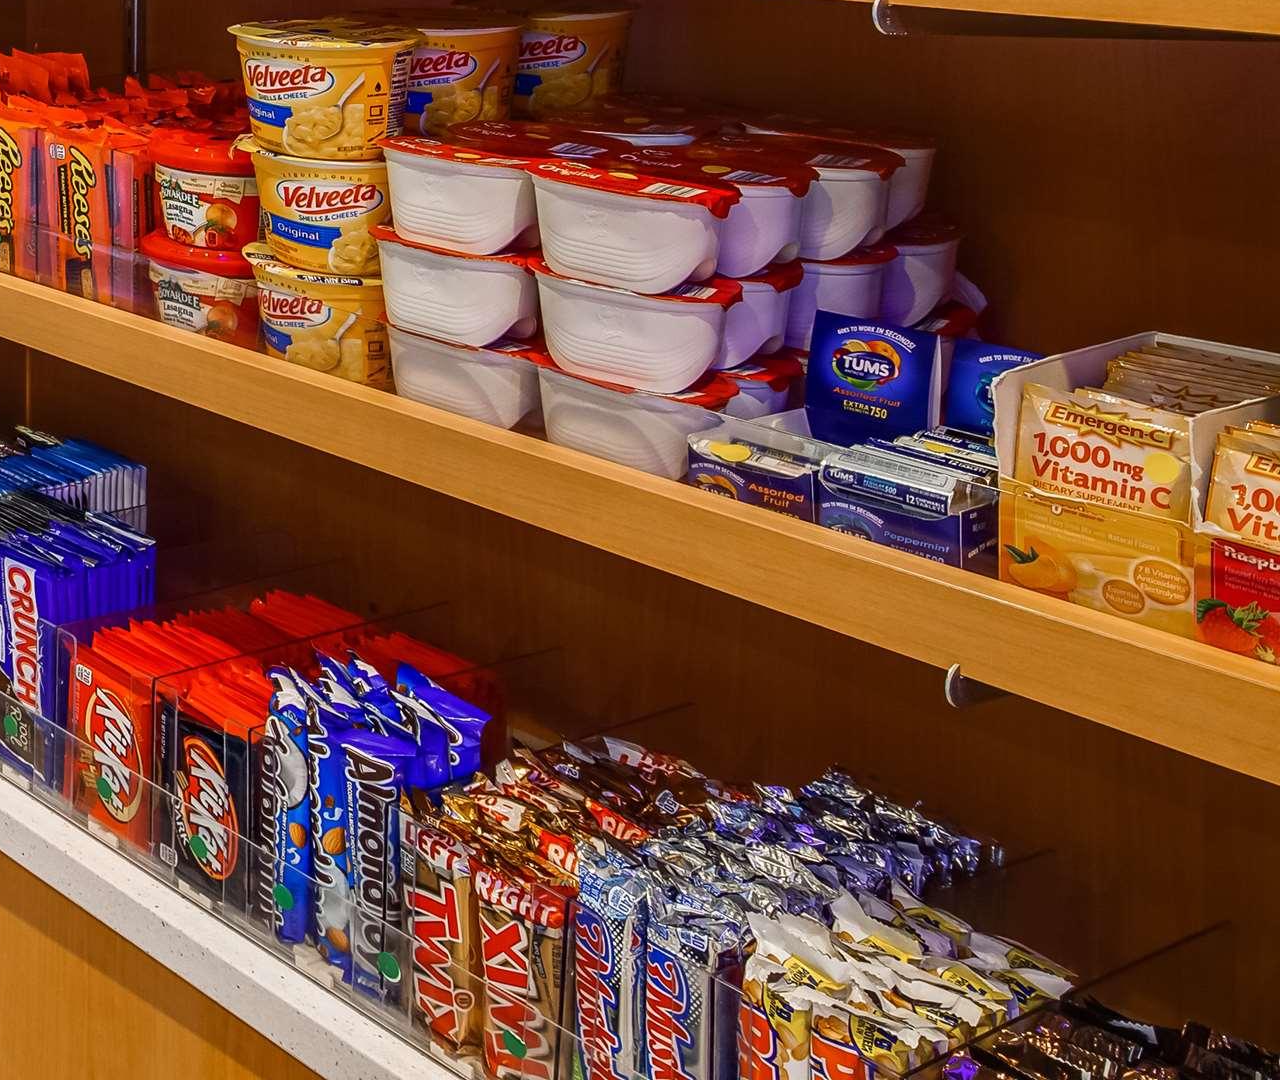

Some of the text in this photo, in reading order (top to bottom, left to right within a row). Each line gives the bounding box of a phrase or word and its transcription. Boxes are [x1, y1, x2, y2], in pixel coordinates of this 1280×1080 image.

[247, 63, 327, 88] Velveeta
[424, 77, 451, 86] CHEESE
[258, 91, 309, 101] SHELLS CHEESE
[538, 163, 601, 180] Original
[68, 145, 96, 259] Reese's
[165, 201, 194, 216] Lasagna
[282, 183, 377, 209] Velveeta
[298, 210, 359, 222] SHELLS CHEESE
[277, 222, 320, 242] Original
[858, 325, 917, 350] WORK IN SECONDS!
[842, 355, 890, 377] TUMS
[1002, 354, 1023, 362] WORK
[843, 399, 888, 419] EXTRA 750
[1050, 406, 1165, 444] Emergen-C
[1033, 432, 1145, 482] 1,000 mg
[829, 470, 854, 482] TUMS
[1031, 455, 1173, 510] Vitamin C
[747, 482, 805, 503] Assorted
[763, 494, 790, 508] Fruit
[1032, 480, 1074, 497] DIETARY
[1075, 491, 1142, 512] SUPPLEMENT
[6, 564, 39, 708] CRUNCH
[173, 797, 189, 849] DARK
[343, 743, 396, 912] Almond
[405, 818, 462, 870] LEFT
[475, 870, 563, 927] RIGHT
[404, 882, 476, 1043] TWIX
[484, 913, 551, 1080] TWIX
